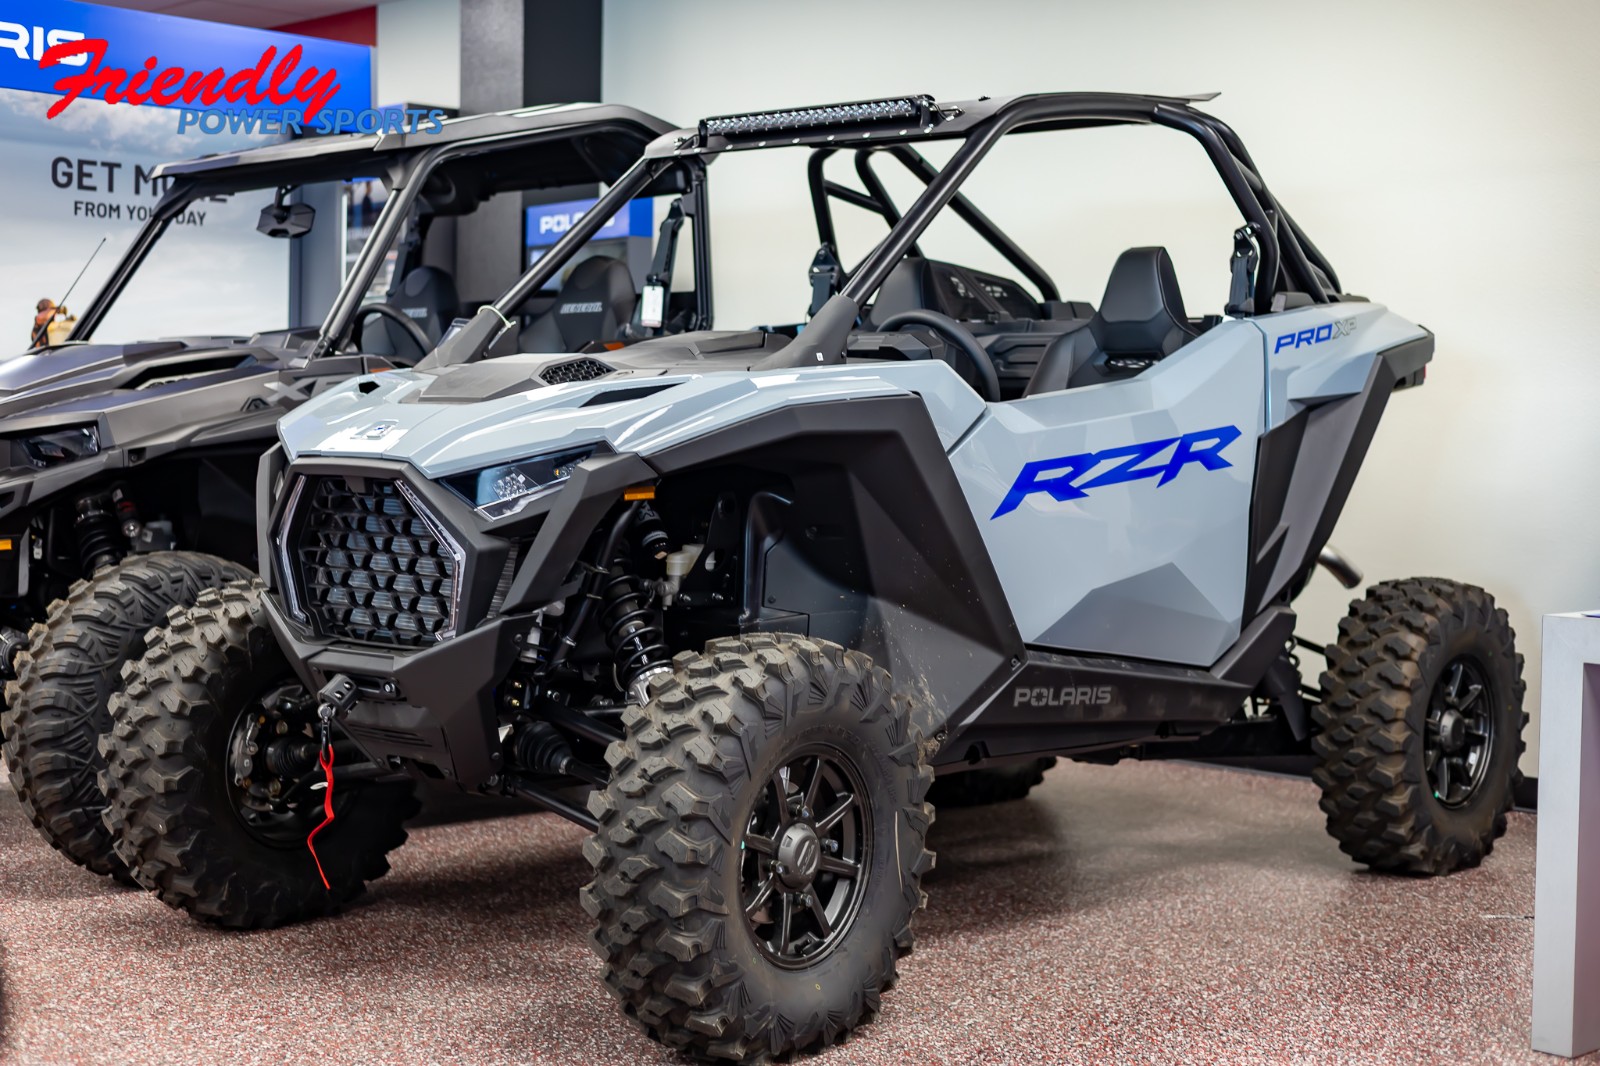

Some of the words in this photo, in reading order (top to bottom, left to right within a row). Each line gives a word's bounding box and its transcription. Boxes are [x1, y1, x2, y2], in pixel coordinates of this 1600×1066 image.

[51, 156, 122, 193] GET
[74, 200, 121, 219] FROM
[127, 205, 154, 221] YO
[990, 425, 1242, 521] RZR
[1013, 685, 1112, 708] POLARIS
